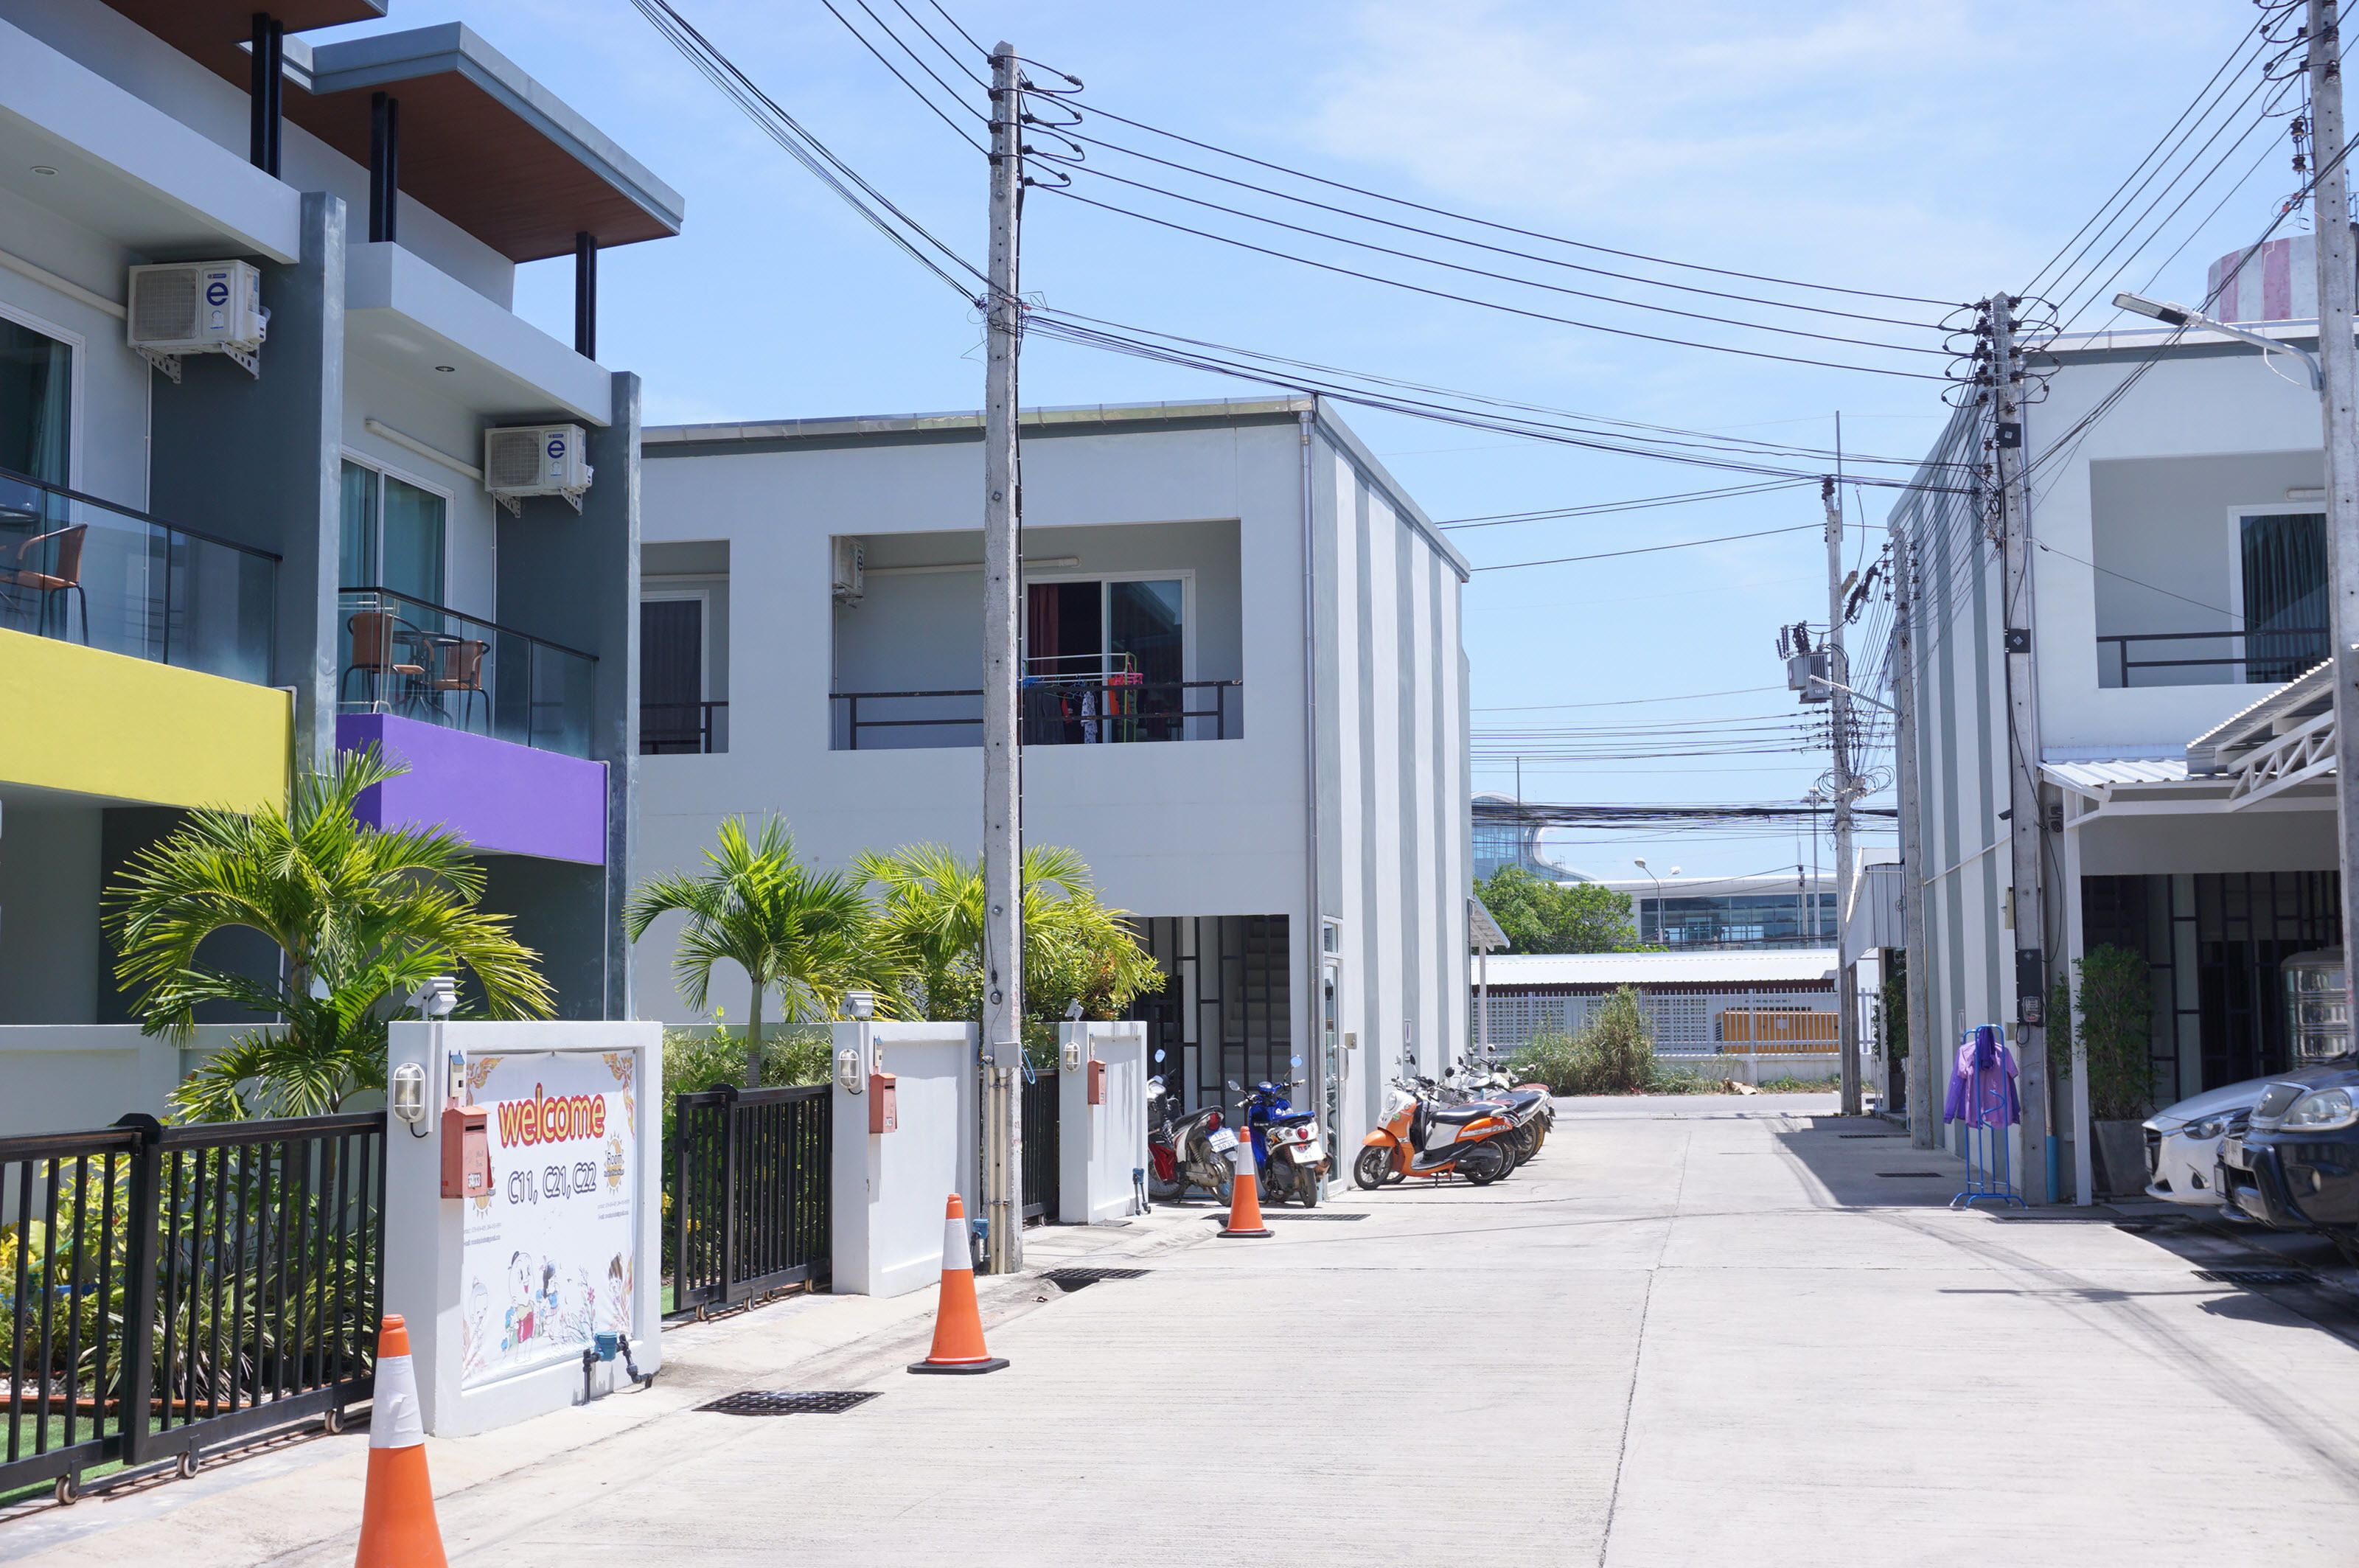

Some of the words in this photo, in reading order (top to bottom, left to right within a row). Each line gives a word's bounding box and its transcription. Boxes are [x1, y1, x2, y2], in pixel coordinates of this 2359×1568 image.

[206, 282, 229, 307] e
[547, 440, 565, 459] e
[498, 1082, 605, 1149] welcome
[507, 1170, 538, 1205] C11,
[543, 1165, 571, 1199] C21,
[572, 1161, 596, 1194] C22
